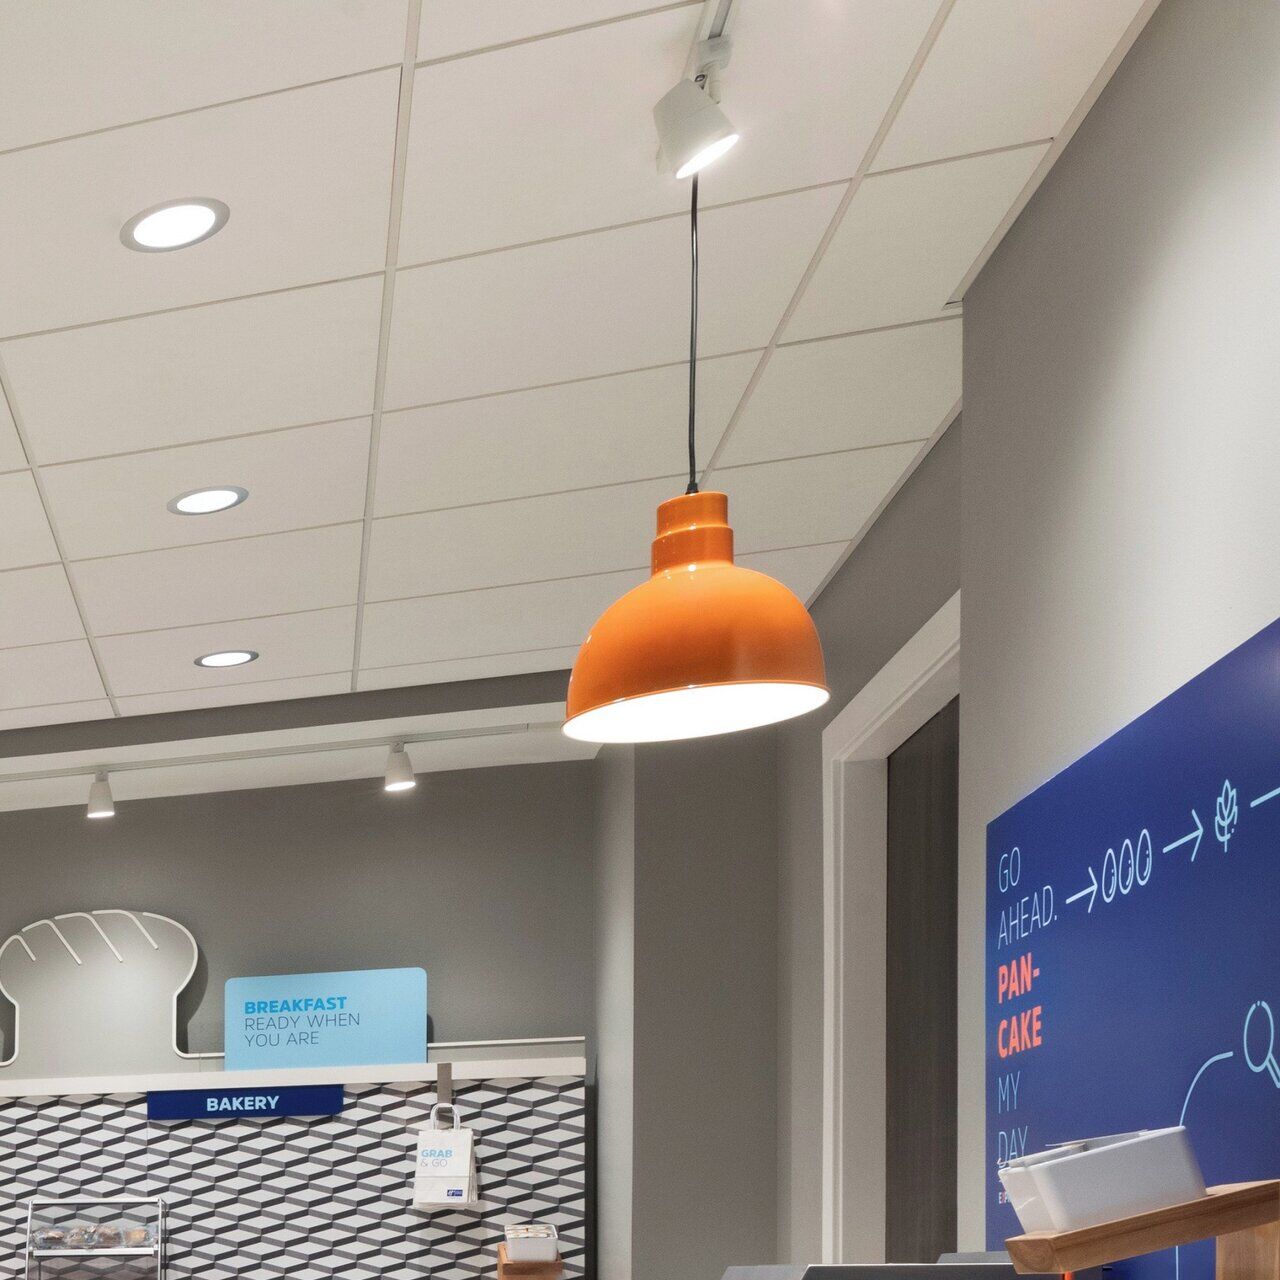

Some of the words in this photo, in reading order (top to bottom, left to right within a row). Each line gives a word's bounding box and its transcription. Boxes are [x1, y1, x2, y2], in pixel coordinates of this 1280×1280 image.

[998, 846, 1021, 893] GO
[997, 885, 1058, 950] AHEAD.
[997, 952, 1040, 1004] PAN-
[244, 996, 347, 1014] BREAKFAST
[245, 1015, 301, 1031] READY
[306, 1012, 360, 1028] WHEN
[997, 1005, 1042, 1059] CAKE
[244, 1033, 280, 1047] YOU
[286, 1031, 319, 1045] ARE
[206, 1095, 280, 1112] BAKERY
[998, 1070, 1021, 1114] MY
[421, 1149, 453, 1158] GRAB
[998, 1125, 1028, 1169] DAY
[420, 1159, 428, 1167] &
[432, 1159, 448, 1168] GO
